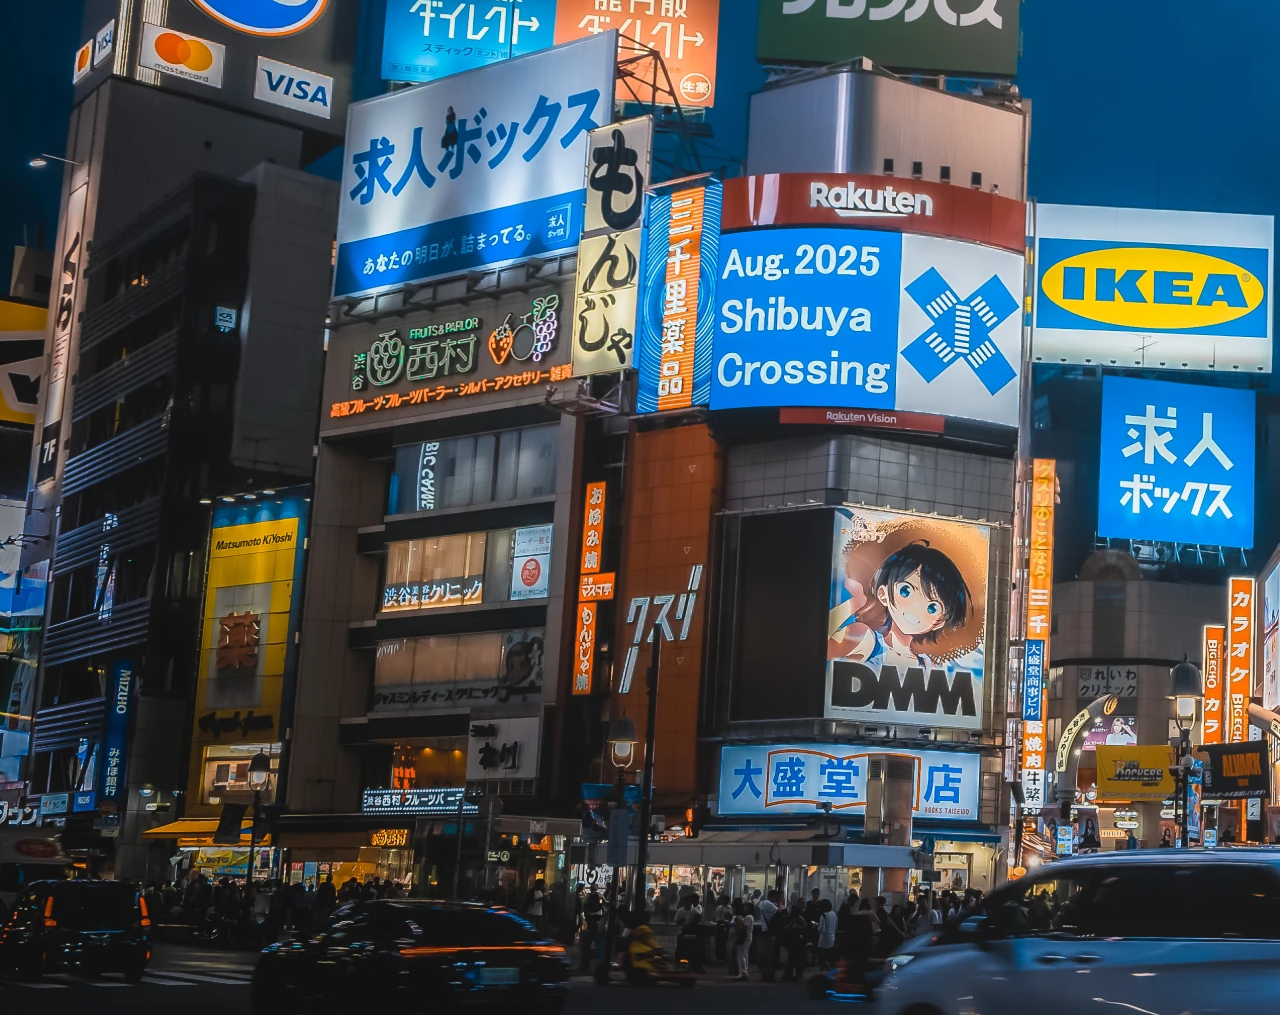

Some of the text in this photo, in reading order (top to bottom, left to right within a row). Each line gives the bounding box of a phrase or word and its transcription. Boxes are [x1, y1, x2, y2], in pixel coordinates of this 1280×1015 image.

[422, 43, 473, 56] スティック
[154, 62, 209, 84] mastercard
[260, 68, 328, 107] VISA
[683, 80, 709, 94] 生薬
[349, 89, 601, 206] 求人ボックス
[810, 182, 933, 218] Rakuten
[363, 223, 532, 275] あなたの明日が、詰まってる。
[577, 128, 643, 365] もんじゃ
[722, 243, 880, 281] Aug. 2025
[1062, 266, 1250, 308] IKEA
[720, 297, 872, 337] Shibuya
[352, 353, 366, 390] 渋谷
[407, 334, 477, 381] 西村
[717, 351, 890, 394] Crossing
[826, 410, 897, 424] Rakuten Vision
[1121, 404, 1235, 471] 求人
[42, 438, 57, 464] 7F
[424, 442, 439, 466] BIC
[1119, 474, 1234, 520] ボックス
[584, 487, 602, 568] お好み焼
[1033, 464, 1051, 579] クスリのことなら
[215, 536, 262, 551] Matsumoto
[215, 610, 261, 670] 薬
[1230, 591, 1250, 683] カラオケ
[1026, 644, 1042, 717] 大盛堂商事ビル
[1094, 669, 1137, 682] れいわ
[1206, 640, 1218, 688] BIG ECHO
[116, 669, 132, 715] MIZUHO
[831, 661, 977, 716] DMM
[1231, 693, 1244, 717] BIG
[105, 747, 121, 796] みずほ銀行
[731, 757, 963, 804] 大盛堂店
[1026, 771, 1041, 802] 牛繁
